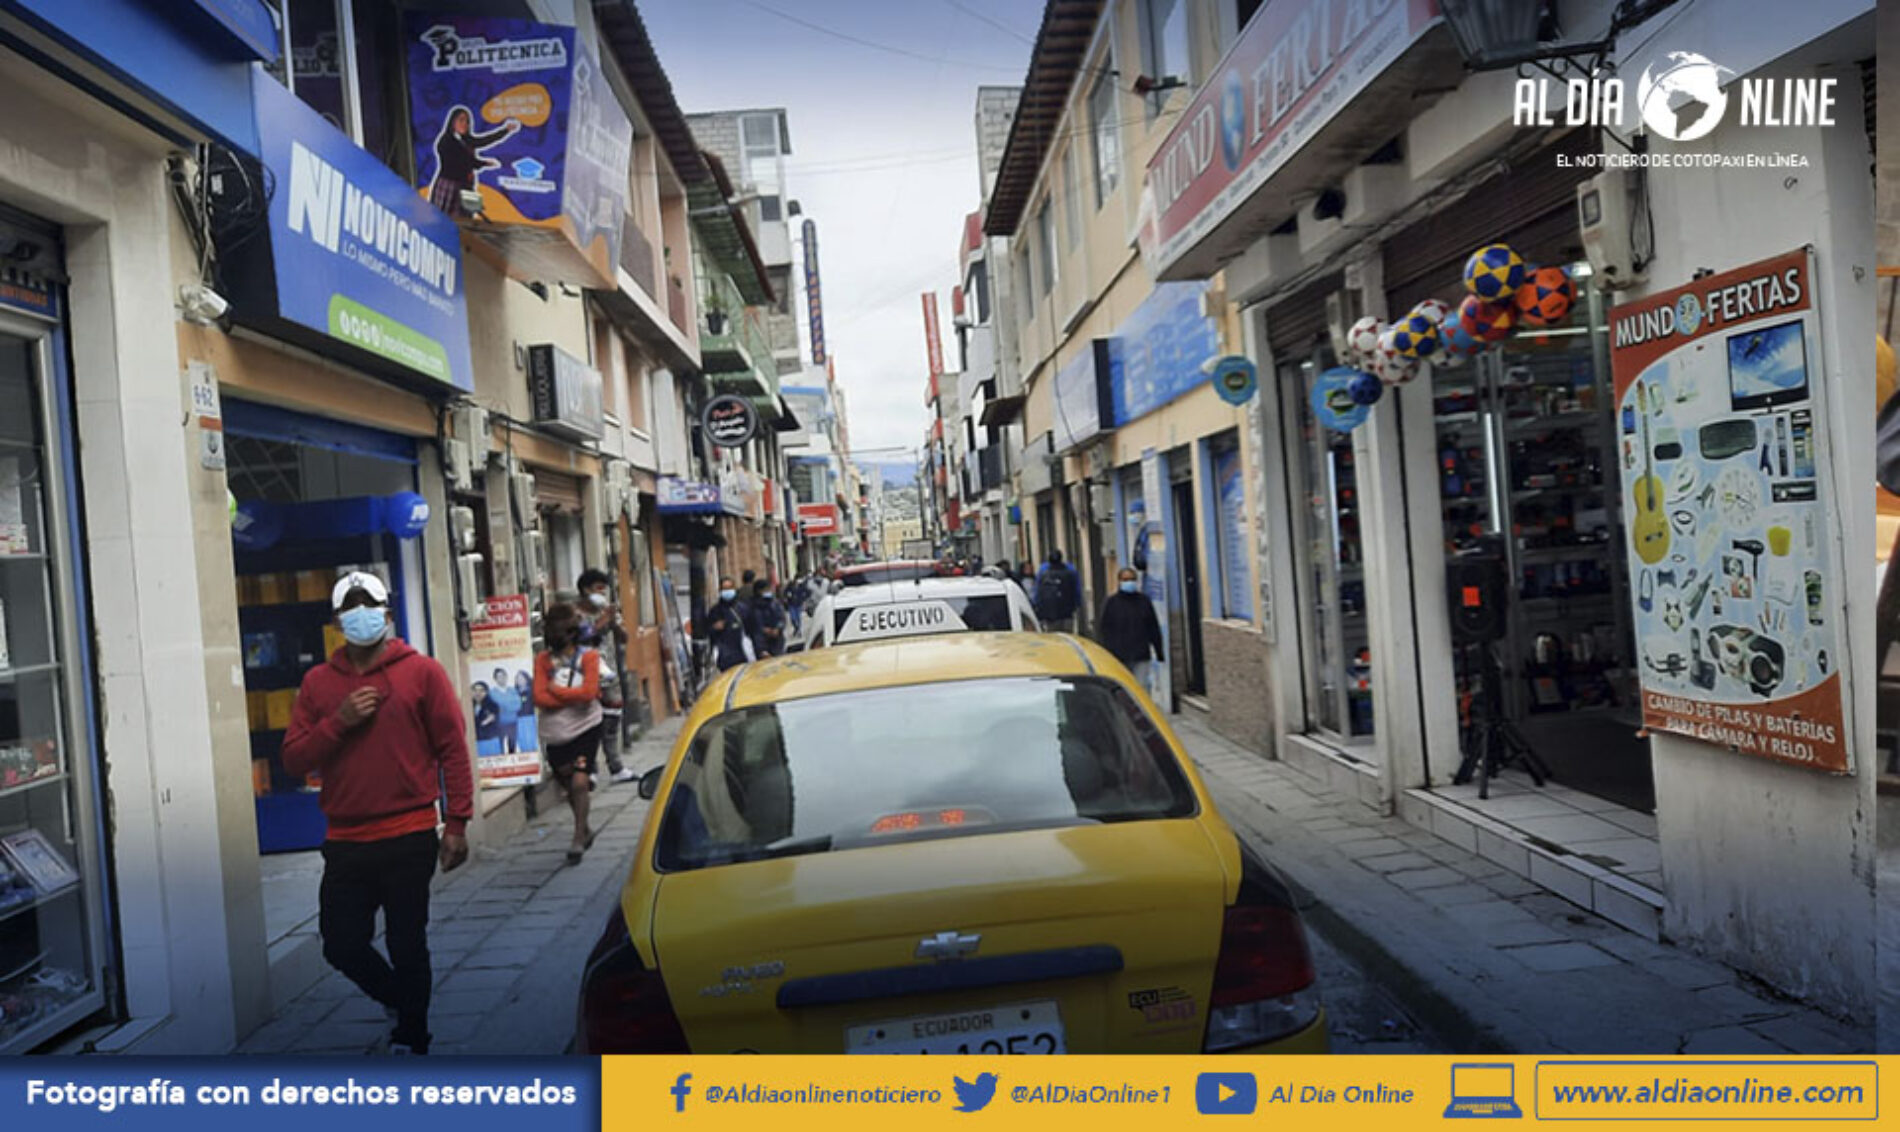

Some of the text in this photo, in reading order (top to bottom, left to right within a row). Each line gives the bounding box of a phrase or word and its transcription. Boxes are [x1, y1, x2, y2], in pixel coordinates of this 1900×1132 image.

[344, 182, 456, 296] NOVICOMPU
[343, 240, 357, 259] LO
[358, 249, 388, 277] MISMO
[1706, 268, 1801, 324] FERTAS
[859, 607, 944, 631] EJECUTIVO
[1648, 694, 1693, 716] CAMBIO
[1696, 703, 1713, 719] DE
[1715, 705, 1750, 728] PILAS
[1752, 713, 1763, 729] Y
[1759, 735, 1769, 751] Y
[1772, 740, 1814, 761] RELOJ
[913, 1014, 994, 1037] ECUADOR
